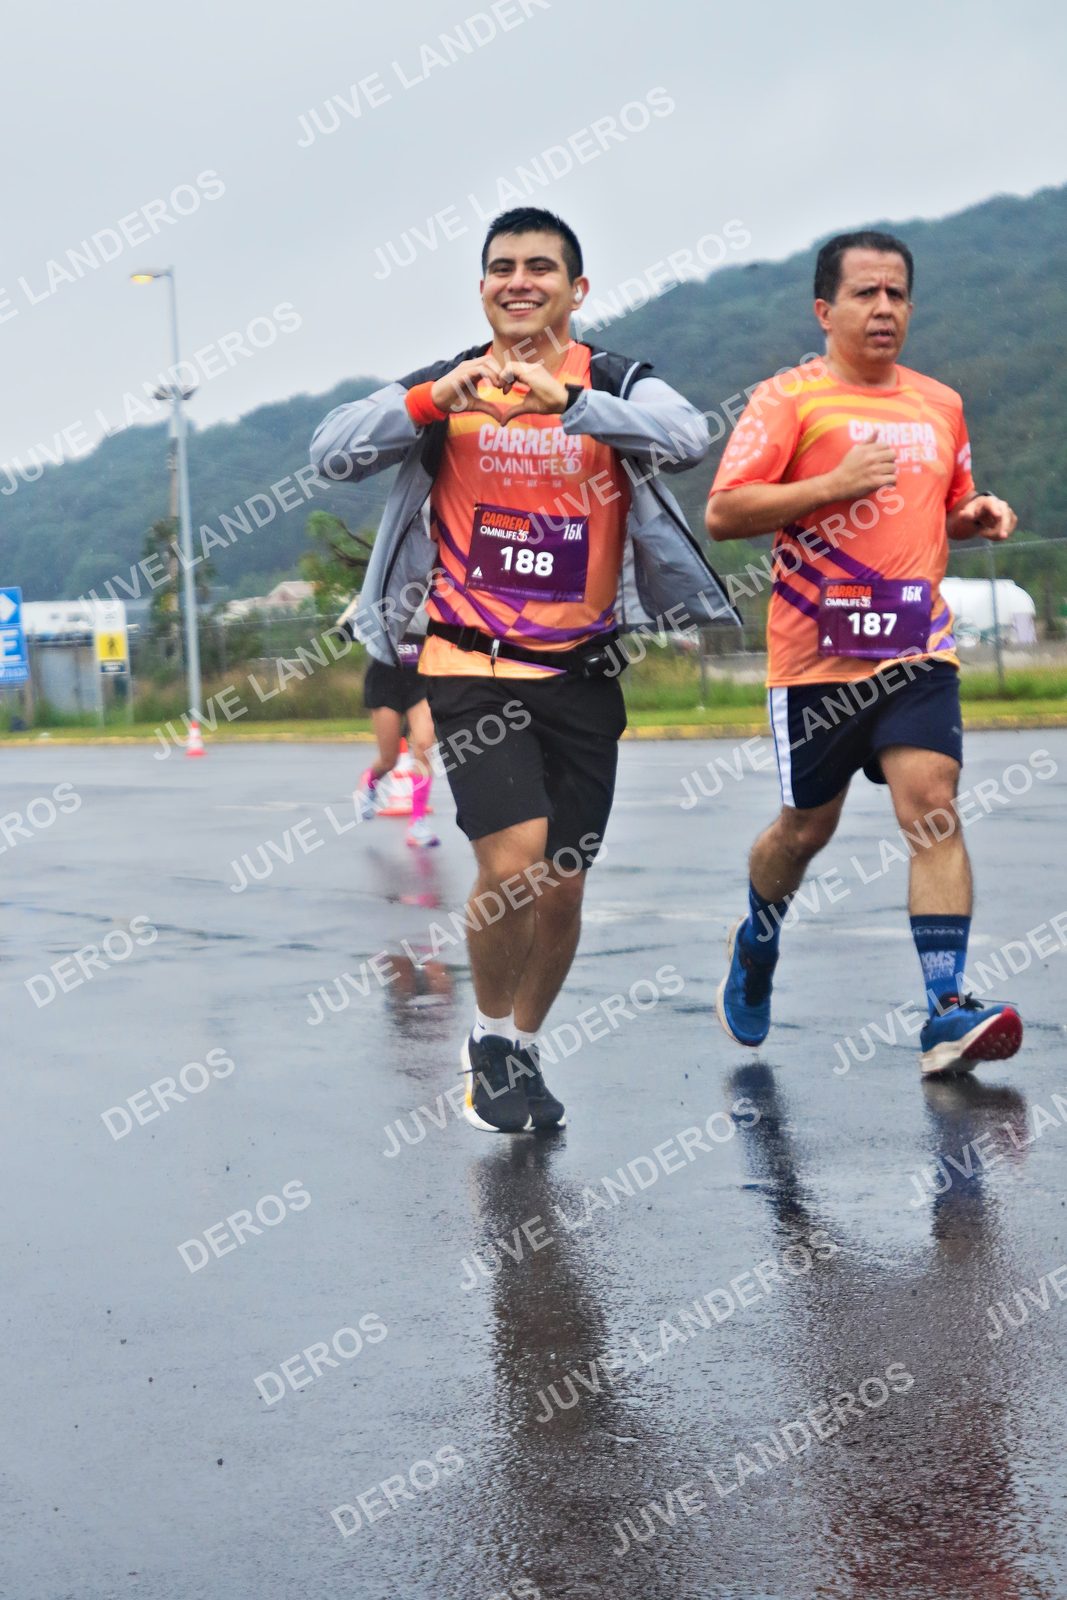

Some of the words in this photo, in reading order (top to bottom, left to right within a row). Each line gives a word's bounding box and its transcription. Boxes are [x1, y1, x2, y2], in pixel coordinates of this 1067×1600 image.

[479, 423, 582, 455] CARRERA
[480, 456, 560, 475] OMNILIFE
[482, 511, 531, 531] CARRERA
[500, 546, 554, 577] 188
[848, 612, 898, 636] 187
